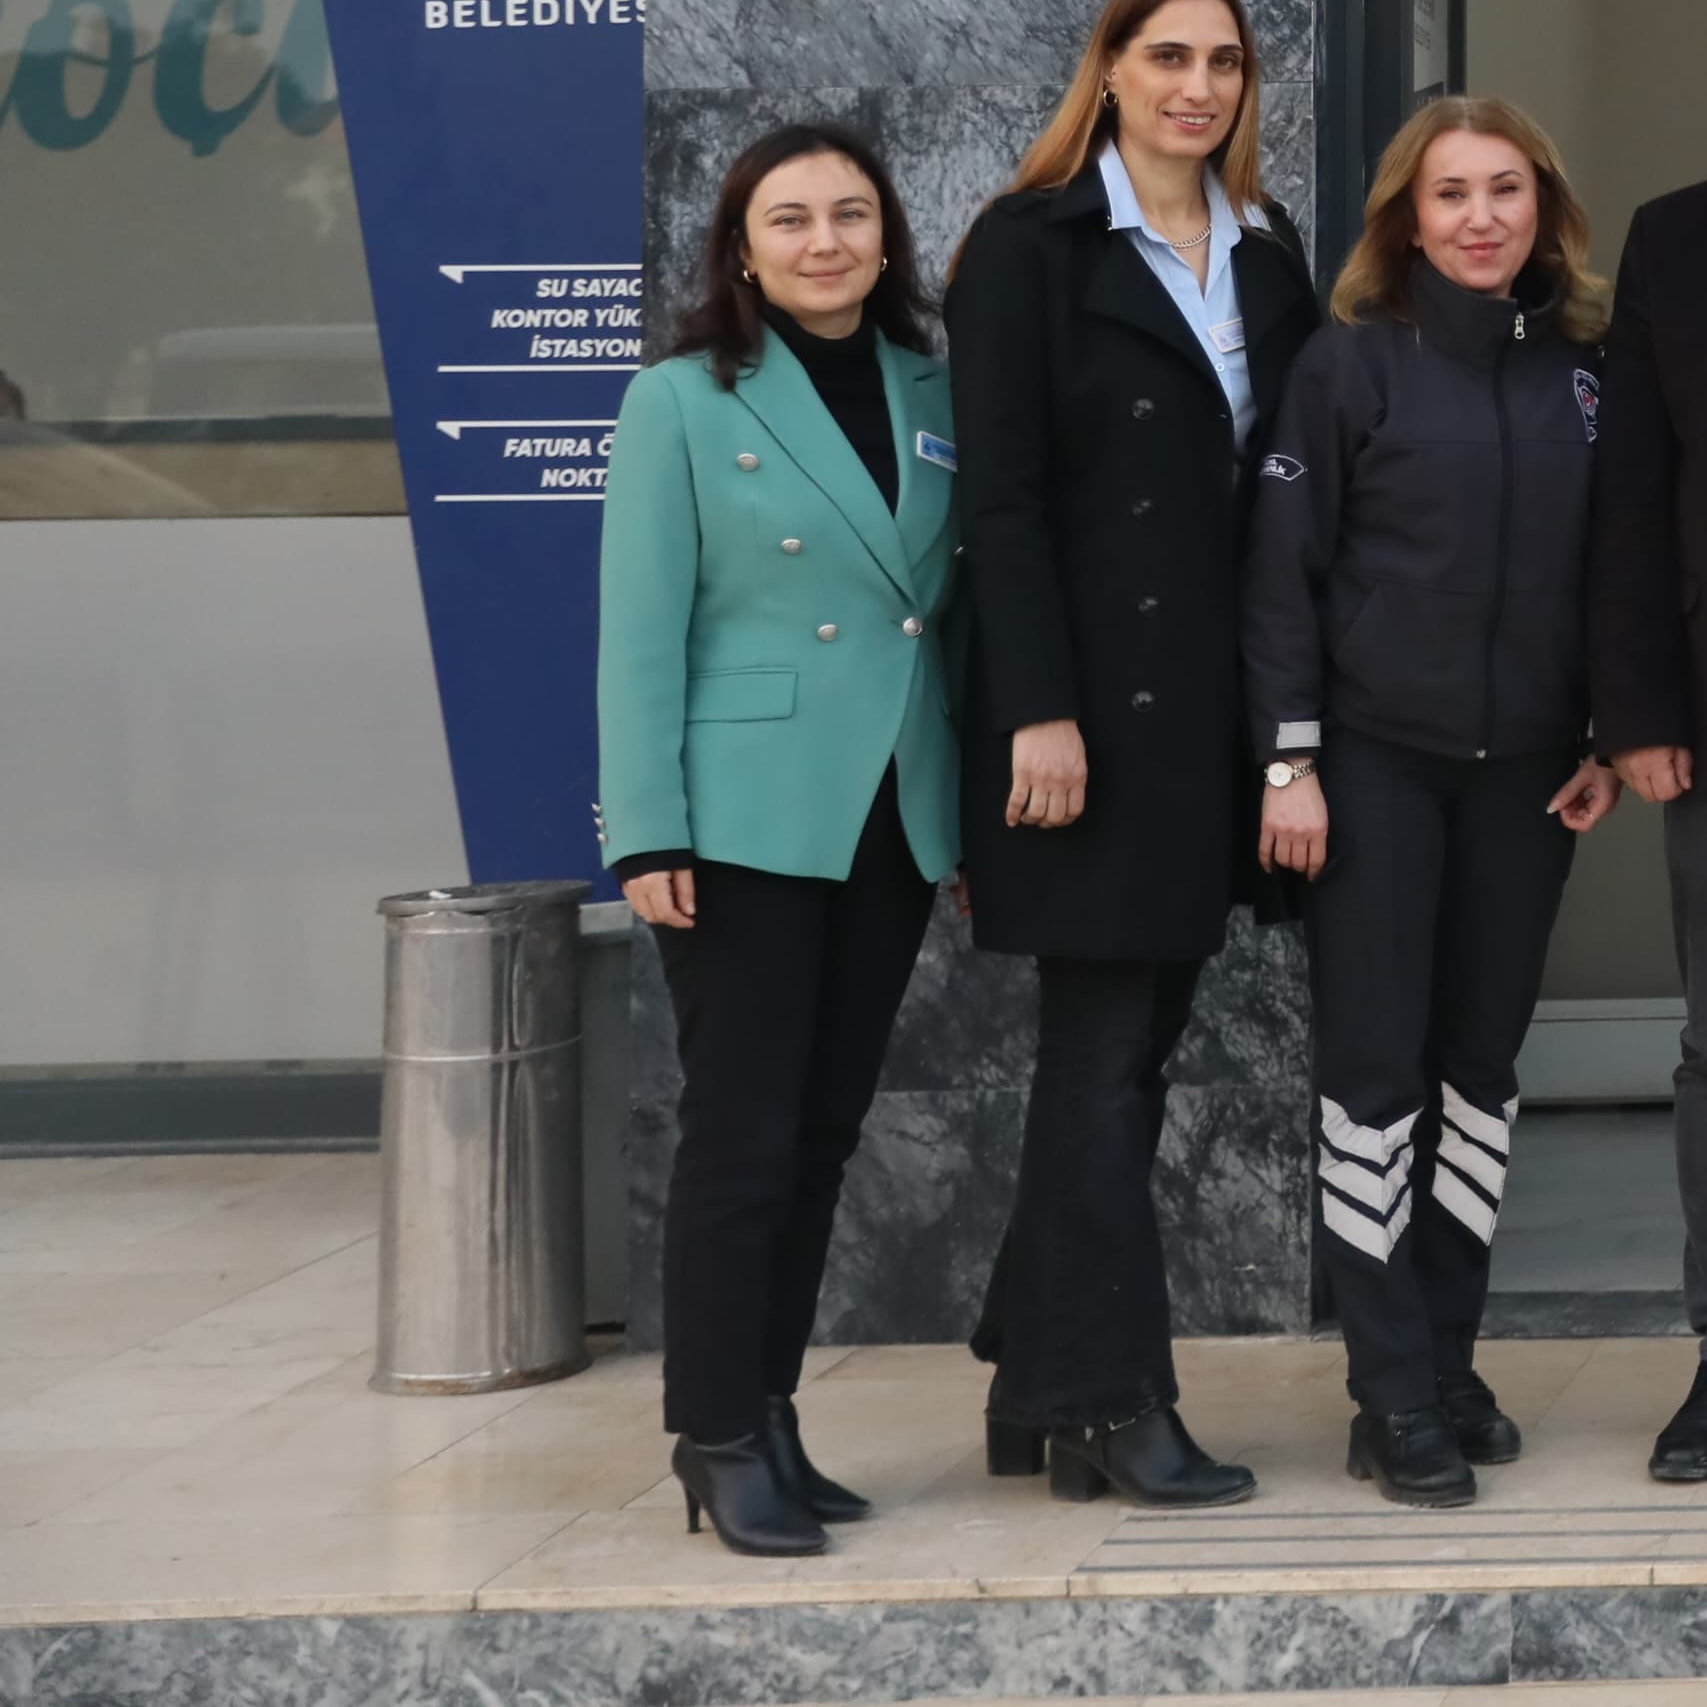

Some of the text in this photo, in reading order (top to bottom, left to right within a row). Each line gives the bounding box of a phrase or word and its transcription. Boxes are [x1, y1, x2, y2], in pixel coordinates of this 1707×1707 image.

[536, 277, 643, 298] SU SAYAC
[491, 304, 643, 329] KONTOR YÜK
[529, 334, 643, 359] İSTASYON
[503, 438, 593, 458] FATURA
[540, 468, 609, 488] NOKT
